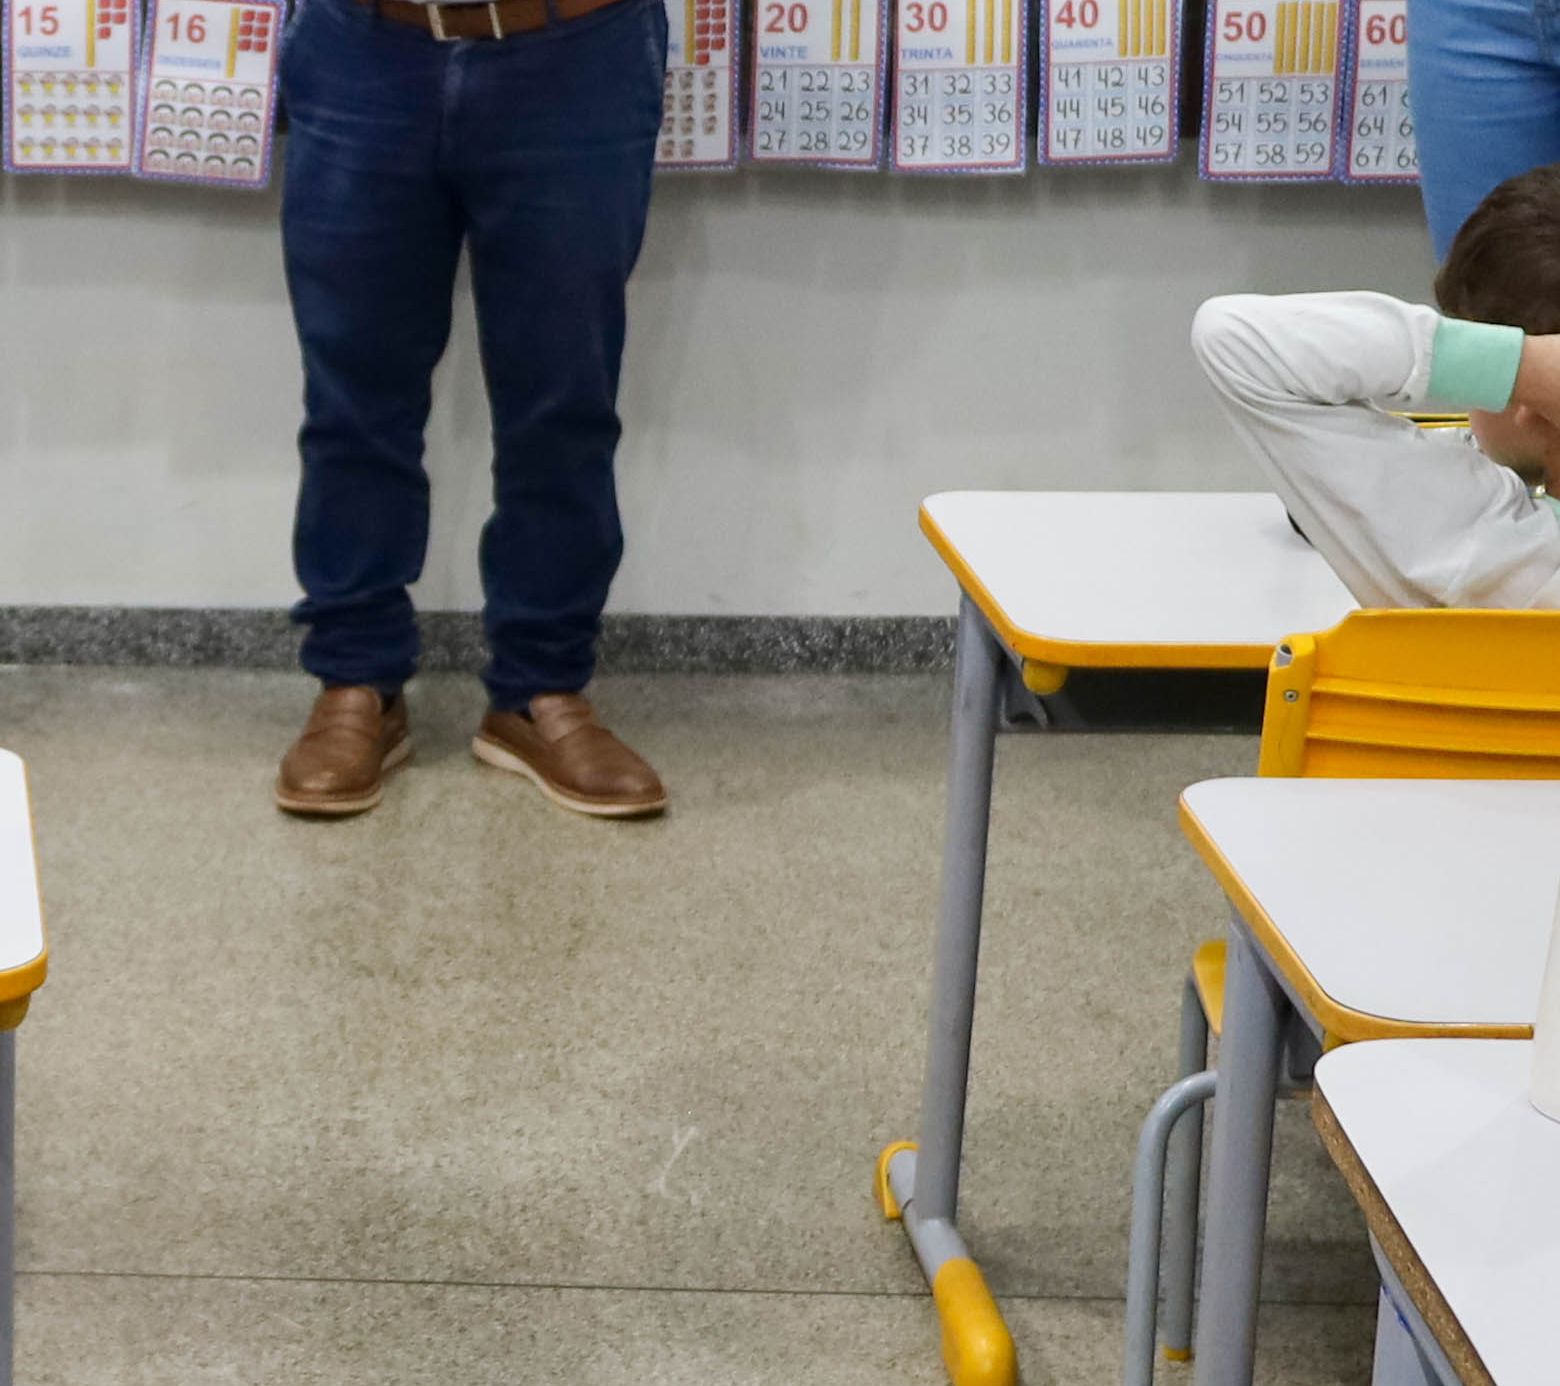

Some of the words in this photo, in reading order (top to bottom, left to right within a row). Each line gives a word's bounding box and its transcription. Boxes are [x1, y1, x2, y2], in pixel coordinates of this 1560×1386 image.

[17, 5, 59, 35] 15
[165, 13, 207, 43] 16
[765, 2, 809, 34] 20
[905, 1, 949, 33] 30
[1222, 12, 1267, 43] 50
[17, 44, 72, 59] QUINZE
[759, 44, 809, 61] VINTE
[900, 45, 954, 61] TRINTA
